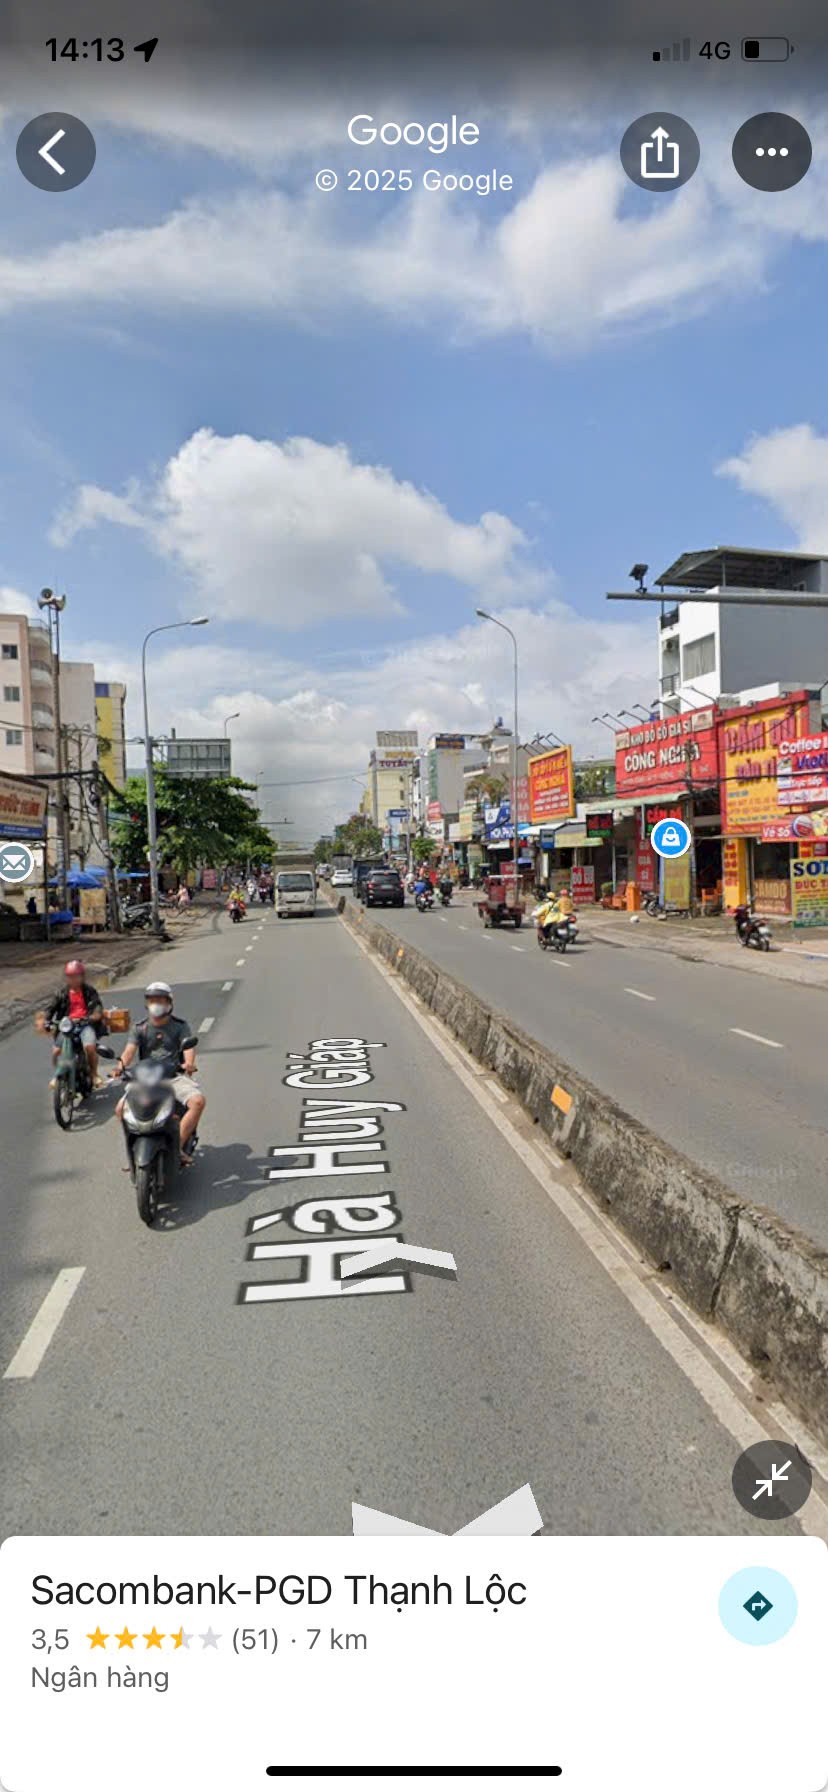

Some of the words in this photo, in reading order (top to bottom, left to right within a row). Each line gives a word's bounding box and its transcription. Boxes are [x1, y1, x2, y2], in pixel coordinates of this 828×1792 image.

[779, 737, 822, 756] Coffee
[624, 750, 656, 773] CÔNG
[660, 741, 701, 766] NGHA
[763, 826, 776, 838] Vé
[777, 825, 790, 837] Số
